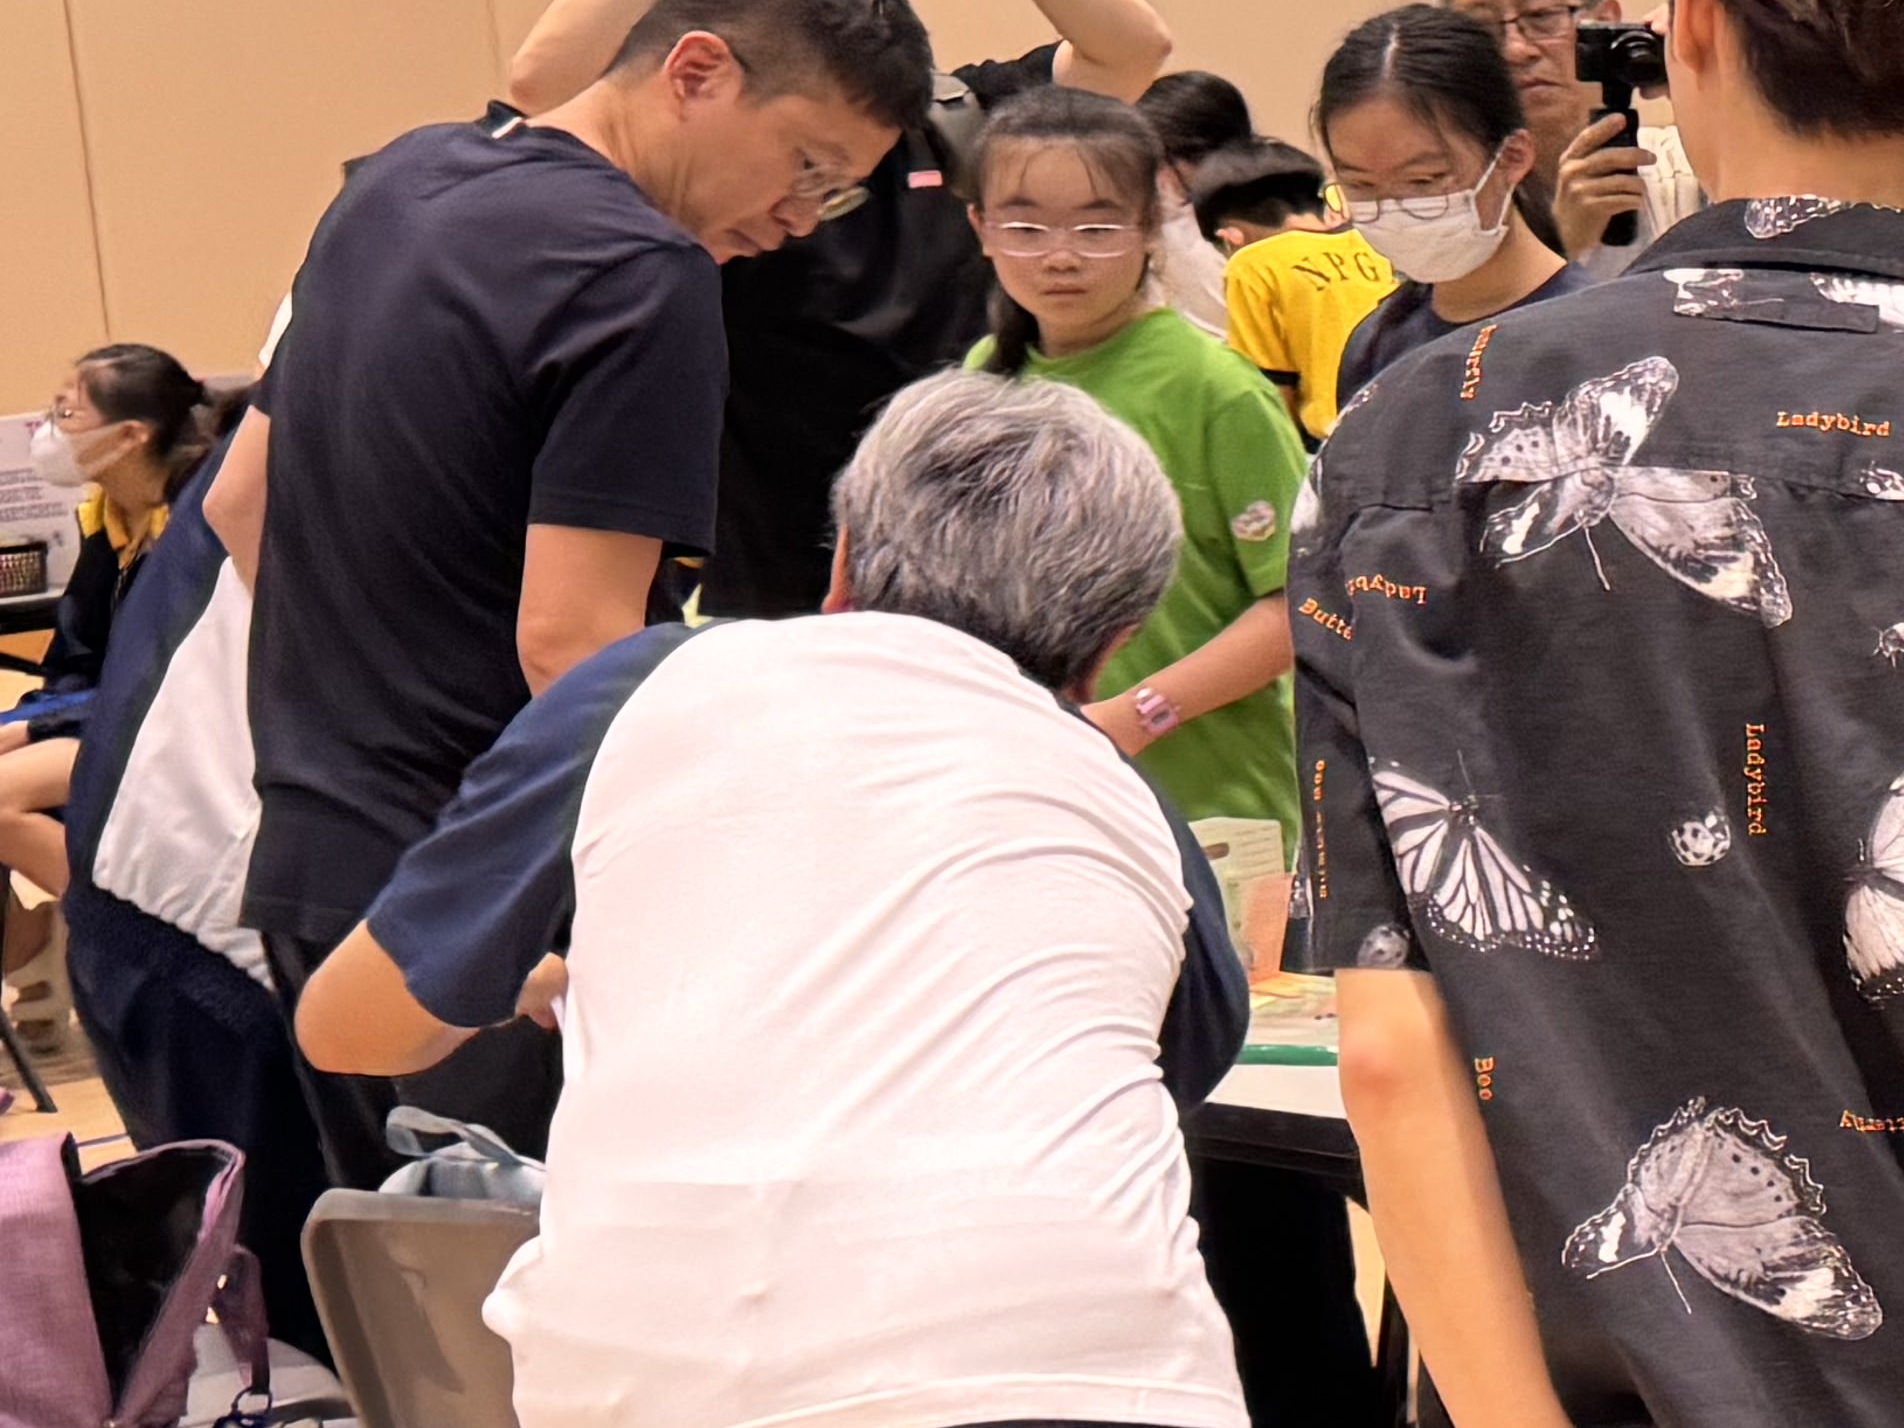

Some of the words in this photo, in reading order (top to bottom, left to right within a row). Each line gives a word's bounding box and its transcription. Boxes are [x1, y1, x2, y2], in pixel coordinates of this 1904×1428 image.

[1292, 251, 1380, 292] NPG
[1776, 410, 1891, 439] Ladybird
[1743, 723, 1769, 836] Ladybird
